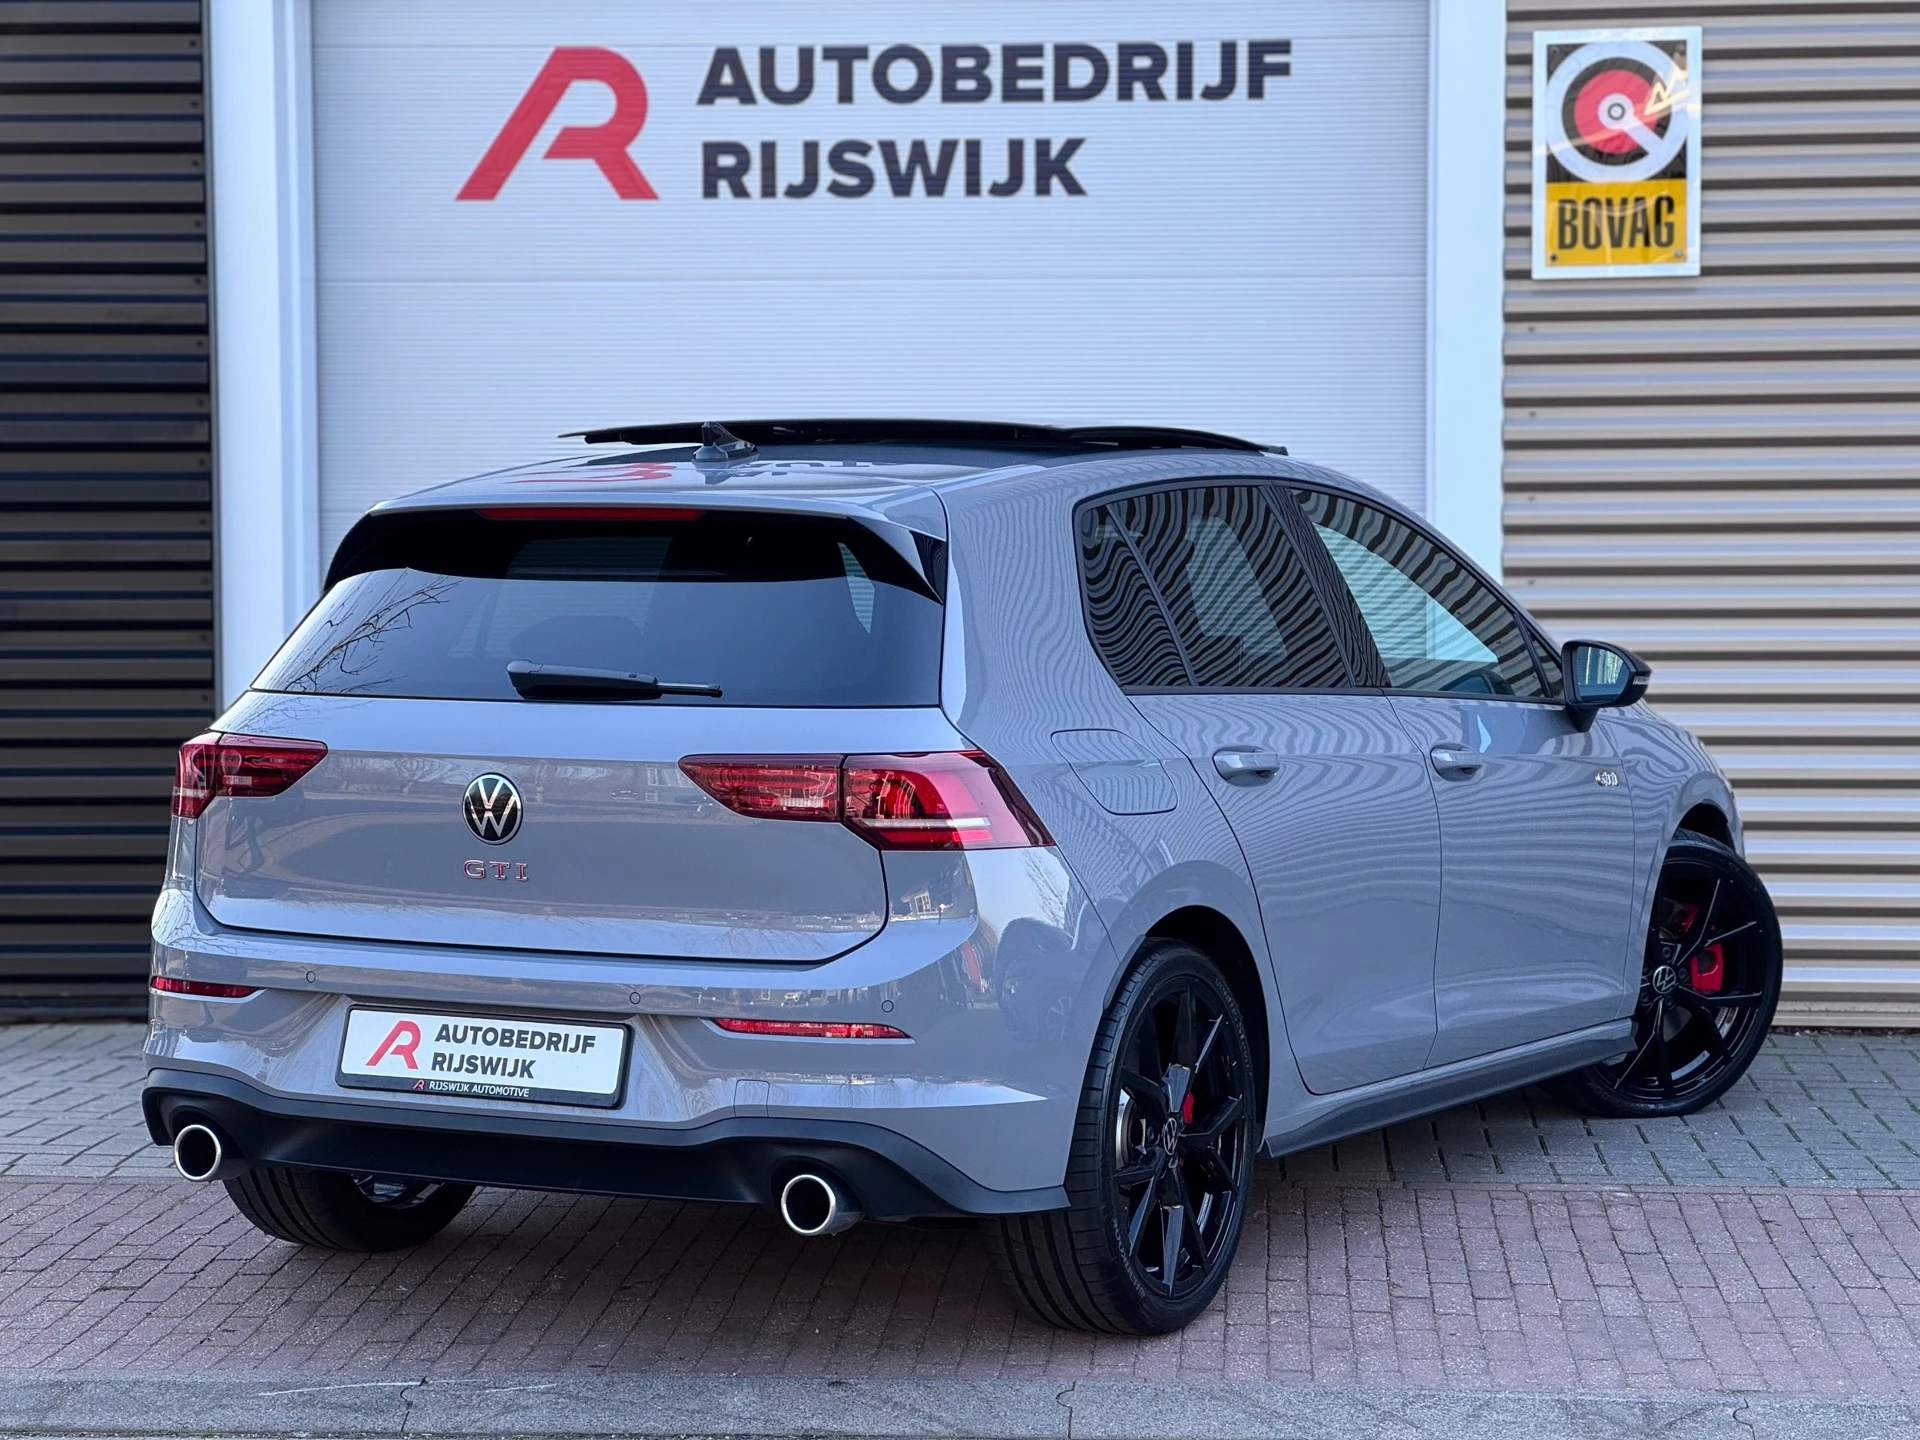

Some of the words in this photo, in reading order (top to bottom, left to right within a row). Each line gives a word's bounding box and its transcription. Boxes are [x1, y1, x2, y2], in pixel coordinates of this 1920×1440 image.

[697, 40, 1292, 105] AUTOBEDRIJF
[702, 138, 1086, 199] RIJSWIJK
[1558, 195, 1675, 250] BOVAG
[463, 859, 528, 880] GTI
[434, 1023, 597, 1055] AUTOBEDRIJF
[430, 1052, 536, 1079] RIJSWIJK
[428, 1080, 471, 1093] RIJSWIJK
[471, 1083, 531, 1098] AUTOMOTIVE
